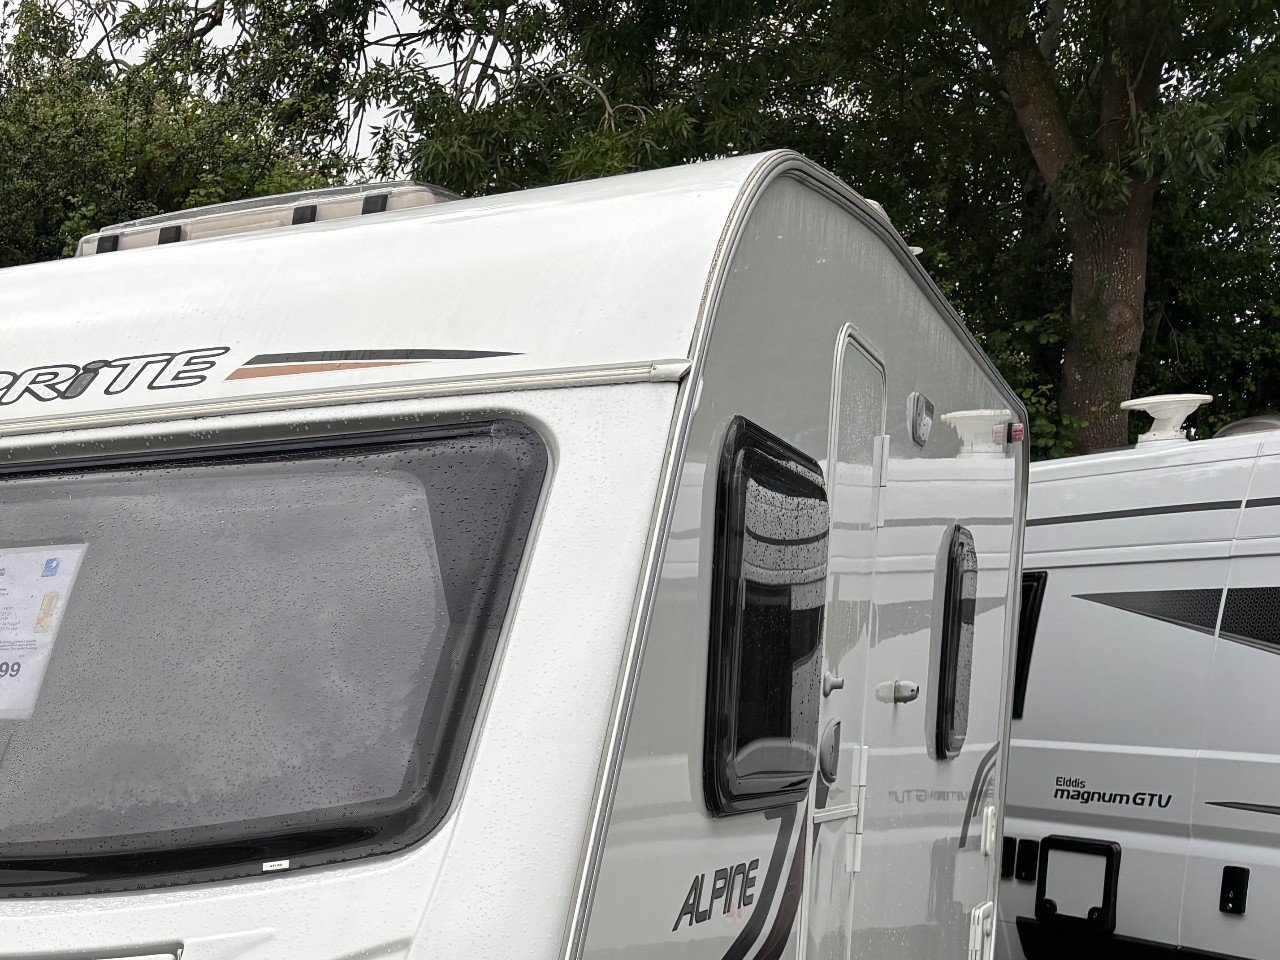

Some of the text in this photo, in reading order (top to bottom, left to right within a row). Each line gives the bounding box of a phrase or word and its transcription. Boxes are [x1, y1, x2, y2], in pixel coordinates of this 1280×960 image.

[1055, 776, 1086, 789] Elddis
[1053, 788, 1173, 809] magnum GTV
[671, 858, 760, 932] ALPINE
